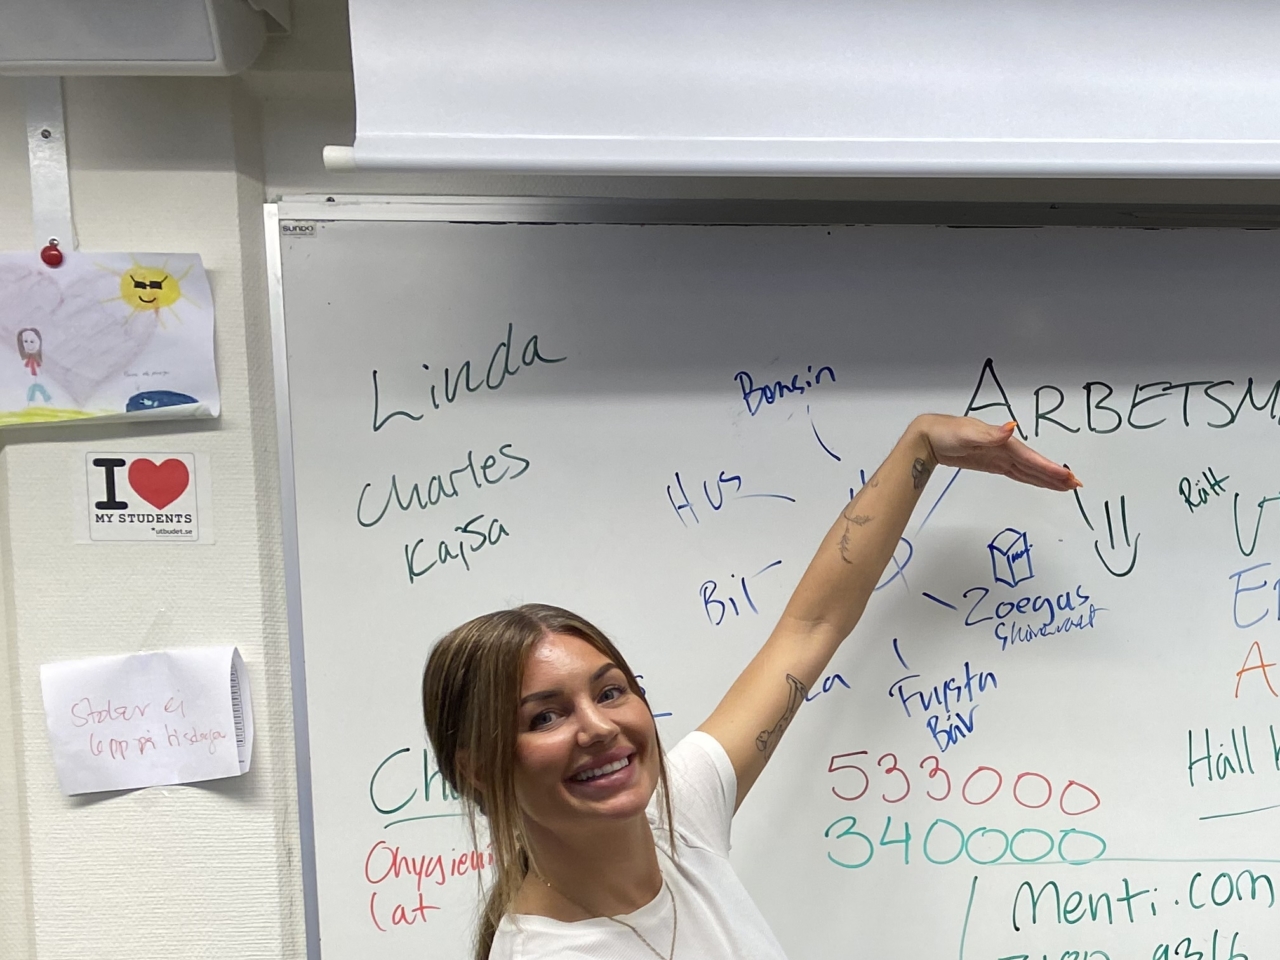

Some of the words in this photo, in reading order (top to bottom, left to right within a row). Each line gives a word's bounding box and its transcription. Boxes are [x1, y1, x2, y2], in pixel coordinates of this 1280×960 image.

[373, 322, 567, 431] Linda
[92, 457, 128, 510] I
[357, 443, 530, 528] Charles
[95, 513, 114, 523] MY
[118, 513, 192, 523] STUDENTS
[405, 514, 509, 584] Kajsa
[700, 574, 758, 626] Bil
[828, 751, 1101, 815] 533000
[824, 816, 1107, 868] 340000
[1013, 869, 1275, 931] Menti.com
